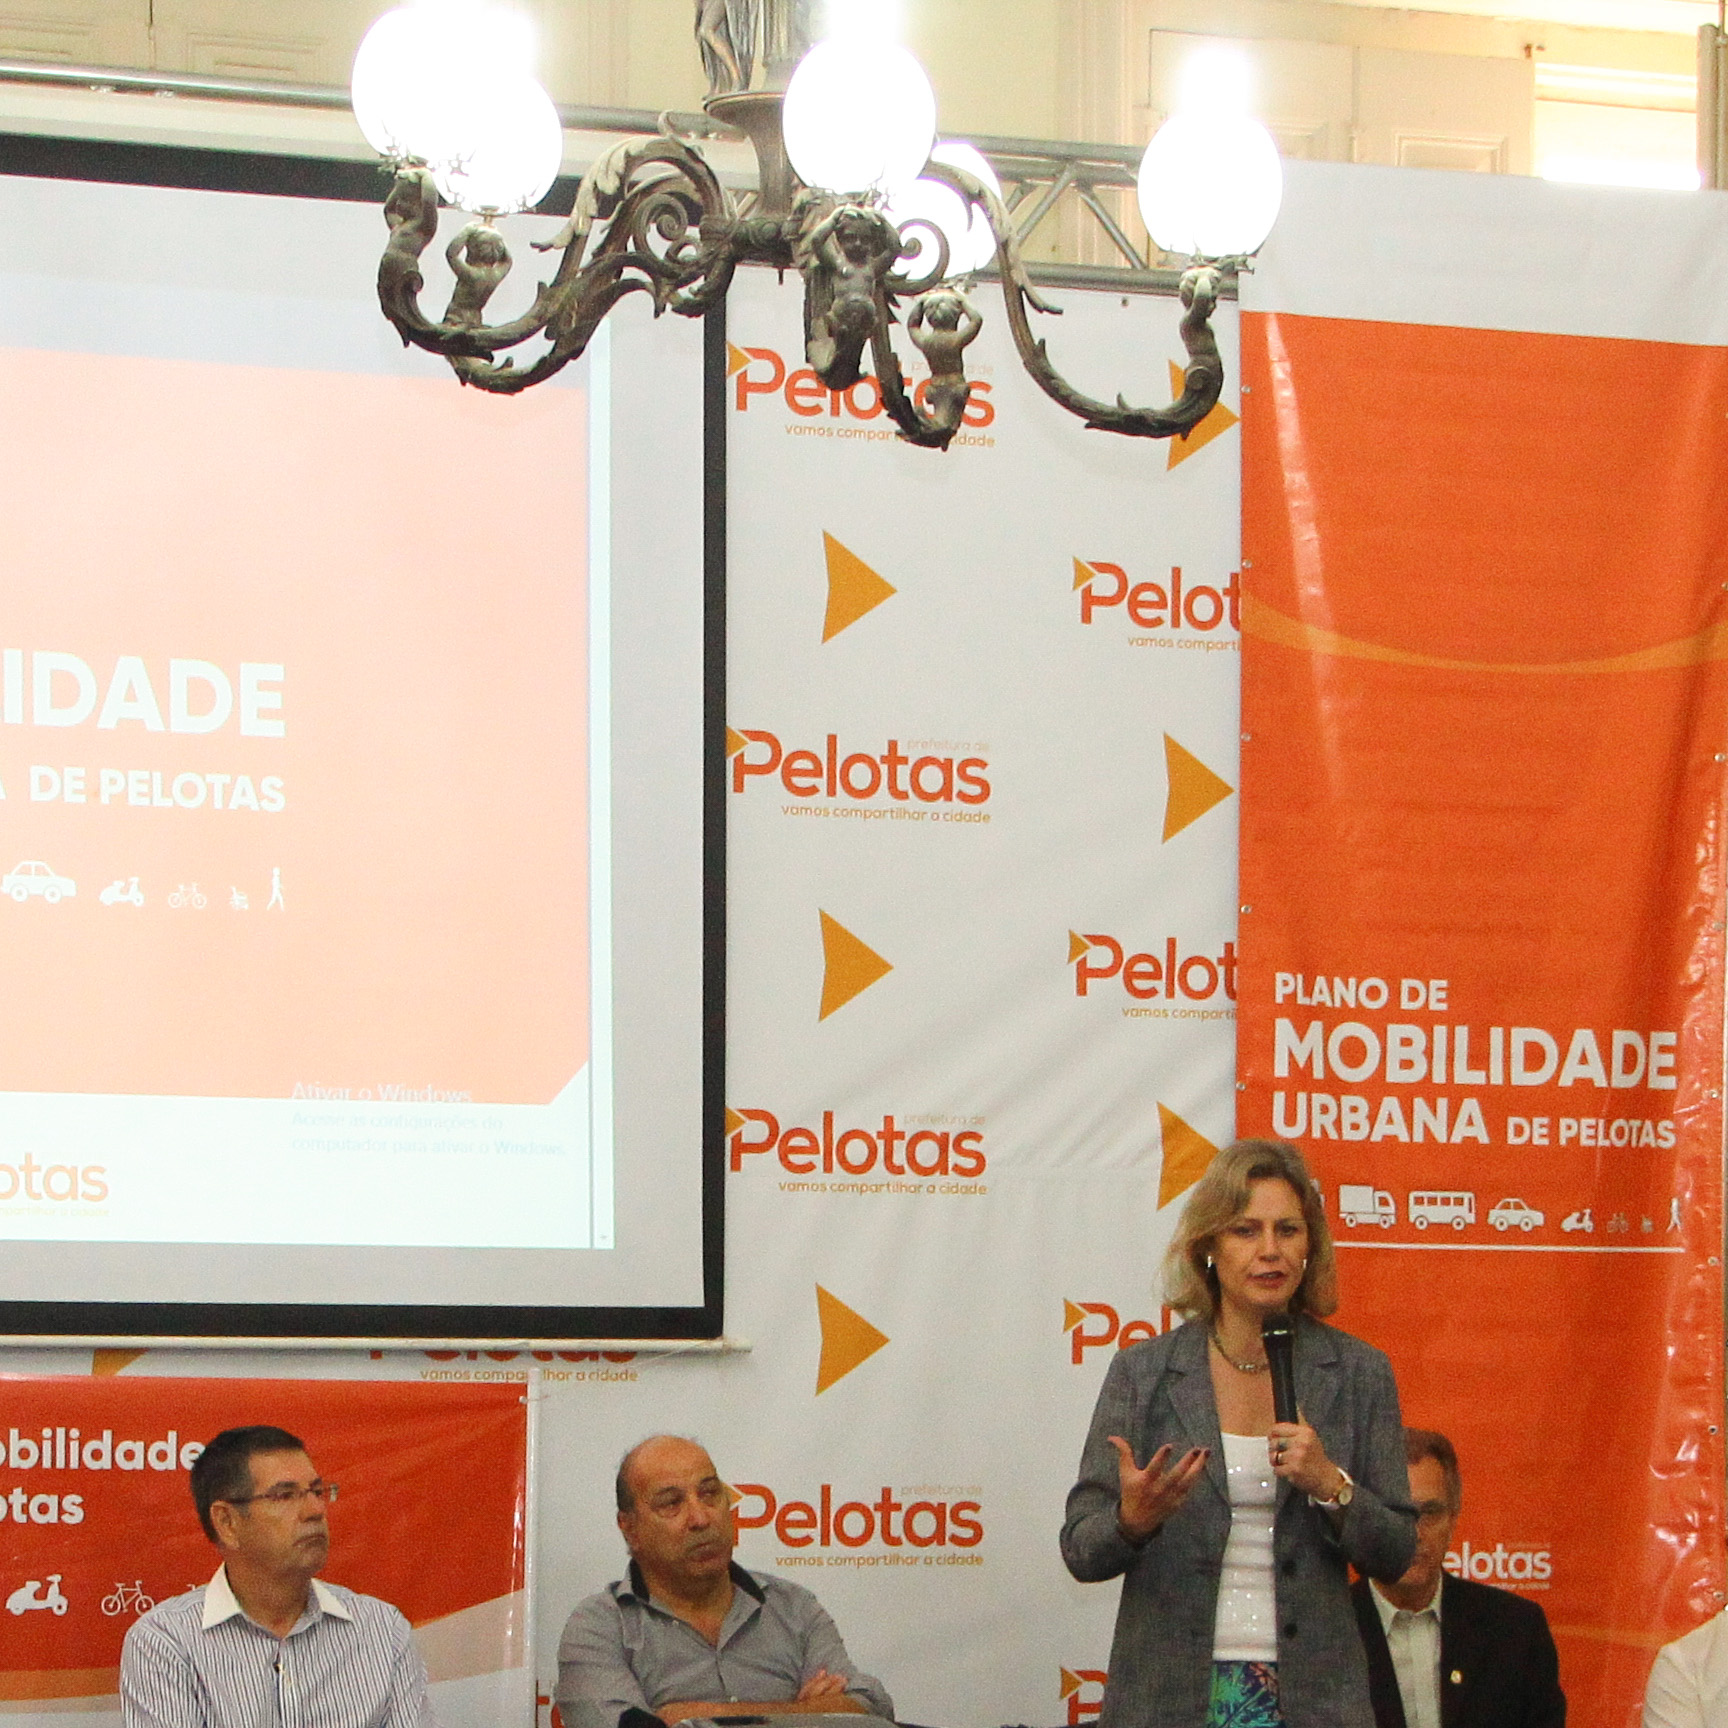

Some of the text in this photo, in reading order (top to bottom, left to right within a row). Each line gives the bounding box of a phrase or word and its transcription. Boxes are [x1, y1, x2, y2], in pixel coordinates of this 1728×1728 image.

[786, 422, 834, 438] vamos
[1128, 636, 1175, 648] vamos
[733, 730, 991, 805] Pelotas
[29, 766, 87, 804] DE
[100, 768, 286, 813] PELOTAS
[782, 803, 991, 824] vamos compartilhar a cidade
[1275, 972, 1449, 1010] PLANO DE
[1122, 1007, 1169, 1019] vamos
[1274, 1017, 1677, 1090] MOBILIDADE
[292, 1081, 471, 1103] Ativar o Windows
[1272, 1091, 1676, 1149] URBANA DE PELOTAS
[730, 1109, 986, 1177] Pelotas
[779, 1181, 988, 1196] vamos compartilhar a cidade
[420, 1369, 470, 1380] vamos
[576, 1371, 585, 1381] a
[589, 1369, 638, 1382] cidade
[731, 1484, 984, 1548] Pelotas
[776, 1553, 984, 1569] vamos compartilhar a cidade
[1442, 1541, 1553, 1580] elotas
